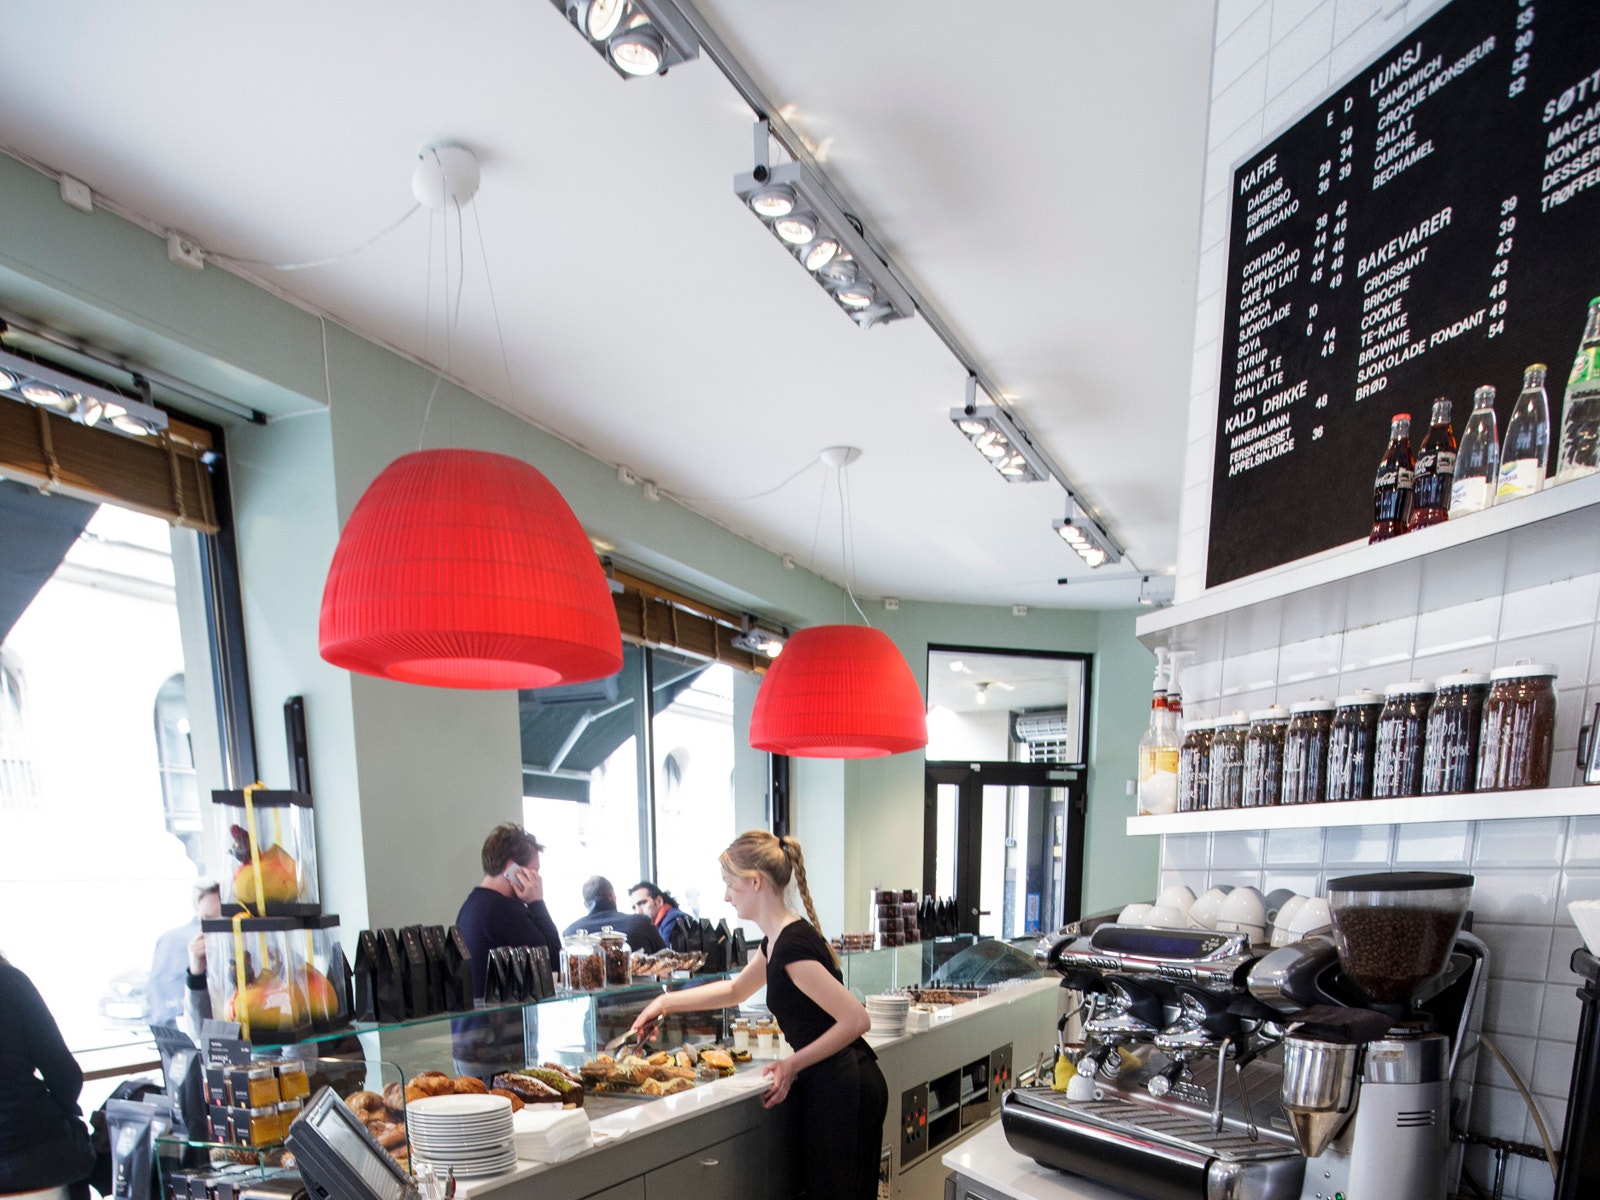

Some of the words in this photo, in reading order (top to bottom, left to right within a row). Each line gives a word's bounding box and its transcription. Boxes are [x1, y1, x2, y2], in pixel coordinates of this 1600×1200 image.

[1370, 41, 1422, 98] LUNSJ
[1376, 114, 1414, 152] SALAT
[1515, 30, 1534, 52] 90
[1378, 54, 1442, 112] SANDWICH
[1378, 86, 1427, 131] CROQUE
[1428, 36, 1496, 96] MONSIEUR
[1326, 110, 1334, 128] E
[1344, 96, 1353, 114] D
[1372, 139, 1435, 190] BECHAMEL
[1508, 76, 1526, 98] 52
[1374, 131, 1416, 170] QUICHE
[1512, 52, 1530, 75] 52
[1544, 123, 1600, 170] KONFE
[1240, 154, 1278, 195] KAFFE
[1246, 188, 1291, 228] ESPRESSO
[1318, 160, 1331, 178] 29
[1340, 144, 1353, 162] 34
[1246, 200, 1300, 246] AMERICANO
[1318, 178, 1330, 196] 36
[1338, 162, 1352, 182] 39
[1248, 177, 1284, 212] DAGENS
[1339, 126, 1353, 144] 39
[1242, 242, 1286, 278] CORTADO
[1316, 213, 1328, 231] 38
[1335, 200, 1348, 218] 42
[1242, 248, 1300, 294] CAPPUCCINO
[1314, 232, 1326, 248] 44
[1334, 218, 1348, 236] 46
[1263, 279, 1276, 298] AU
[1278, 265, 1300, 288] LAIT
[1312, 248, 1324, 266] 44
[1332, 237, 1344, 254] 46
[1357, 206, 1452, 278] BAKEVARER
[1363, 276, 1410, 313] BRIOCHE
[1498, 216, 1516, 236] 39
[1364, 247, 1428, 294] CROISSANT
[1500, 195, 1518, 216] 39
[1238, 302, 1291, 343] SJOKOLADE
[1330, 273, 1342, 290] 49
[1240, 299, 1271, 328] MOCCA
[1310, 267, 1322, 284] 45
[1330, 254, 1344, 272] 48
[1360, 298, 1402, 330] COOKIE
[1496, 237, 1513, 257] 43
[1360, 312, 1408, 348] TE-KAKE
[1491, 259, 1508, 278] 43
[1235, 365, 1266, 391] KANNE
[1270, 356, 1282, 372] TE
[1323, 326, 1336, 343] 44
[1236, 348, 1268, 374] SYRUP
[1306, 323, 1313, 337] 6
[1237, 336, 1260, 360] SOYA
[1308, 304, 1318, 319] 10
[1357, 339, 1426, 384] SJOKOLADE
[1430, 308, 1486, 348] FONDANT
[1488, 300, 1507, 318] 49
[1358, 330, 1410, 366] BROWNIE
[1489, 280, 1507, 299] 48
[1234, 386, 1254, 406] CHAI
[1256, 370, 1284, 396] LATTE
[1321, 341, 1334, 358] 46
[1356, 376, 1388, 402] BRØD
[1488, 320, 1504, 338] 54
[1224, 407, 1256, 434] KALD
[1262, 380, 1308, 416] DRIKKE
[1230, 412, 1290, 450] MINERALVANN
[1316, 394, 1328, 410] 48
[1228, 438, 1295, 478] APPELSINJUICE
[1230, 426, 1292, 464] FERSKPRESSET
[1312, 425, 1324, 441] 36
